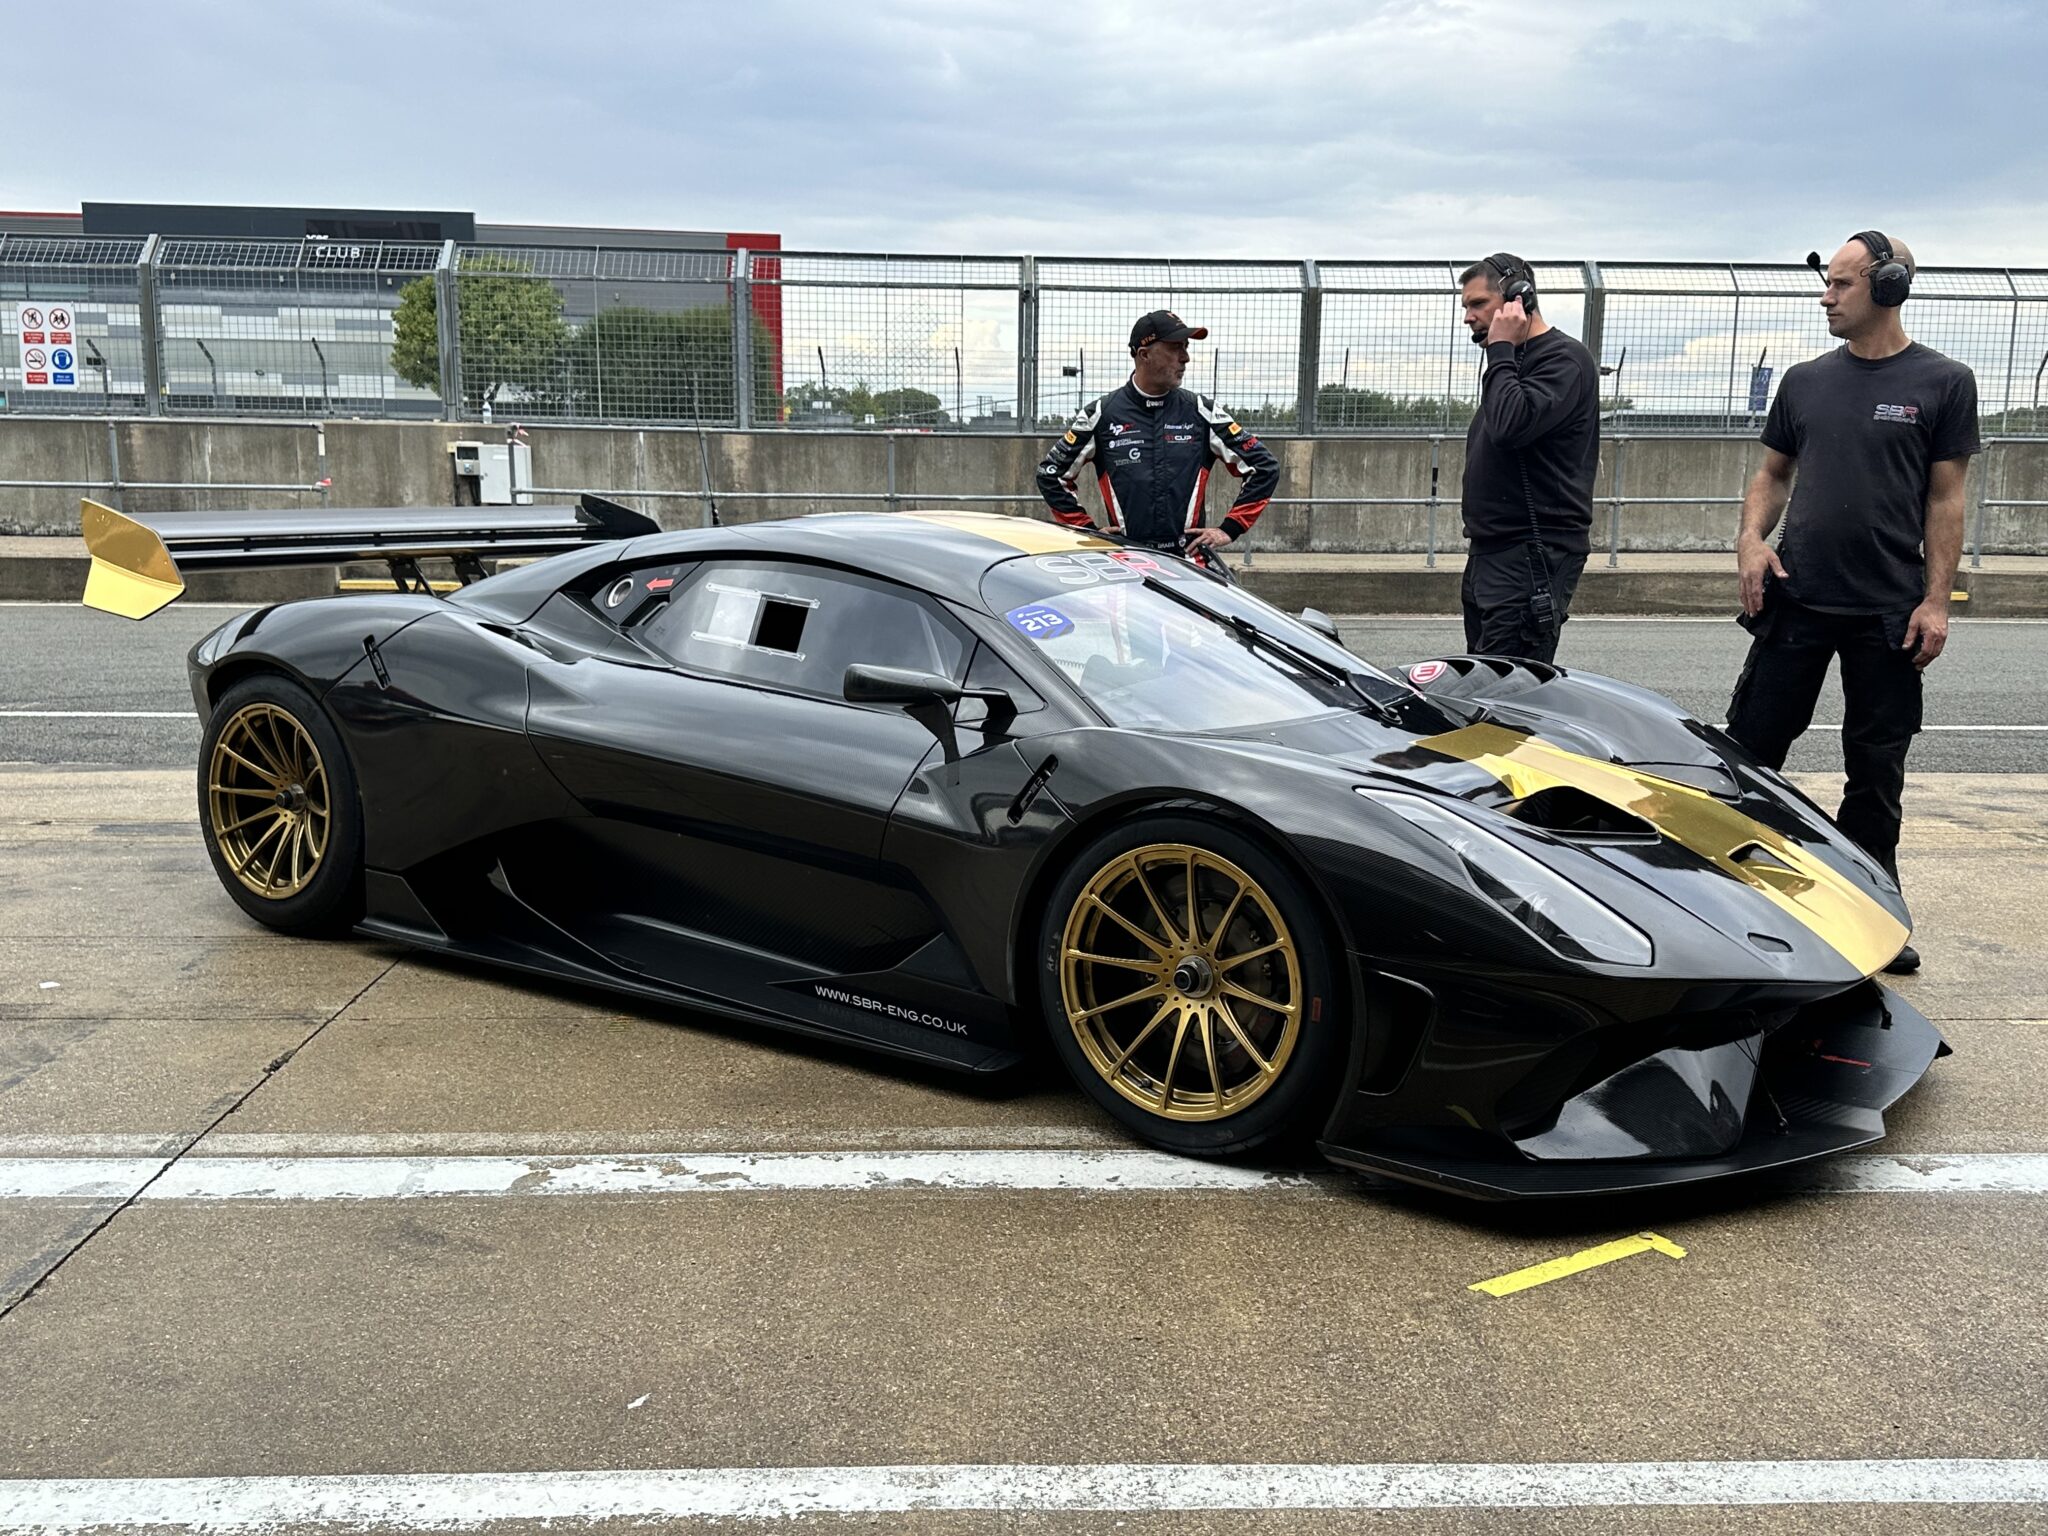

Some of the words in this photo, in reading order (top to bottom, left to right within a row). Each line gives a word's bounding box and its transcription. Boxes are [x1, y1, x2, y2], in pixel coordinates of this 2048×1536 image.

[315, 246, 360, 259] CLUB
[1874, 403, 1920, 418] SBR
[1035, 551, 1182, 585] SBR
[1019, 612, 1064, 632] 213
[814, 984, 969, 1036] WWW.SBR-ENG.CO.UK
